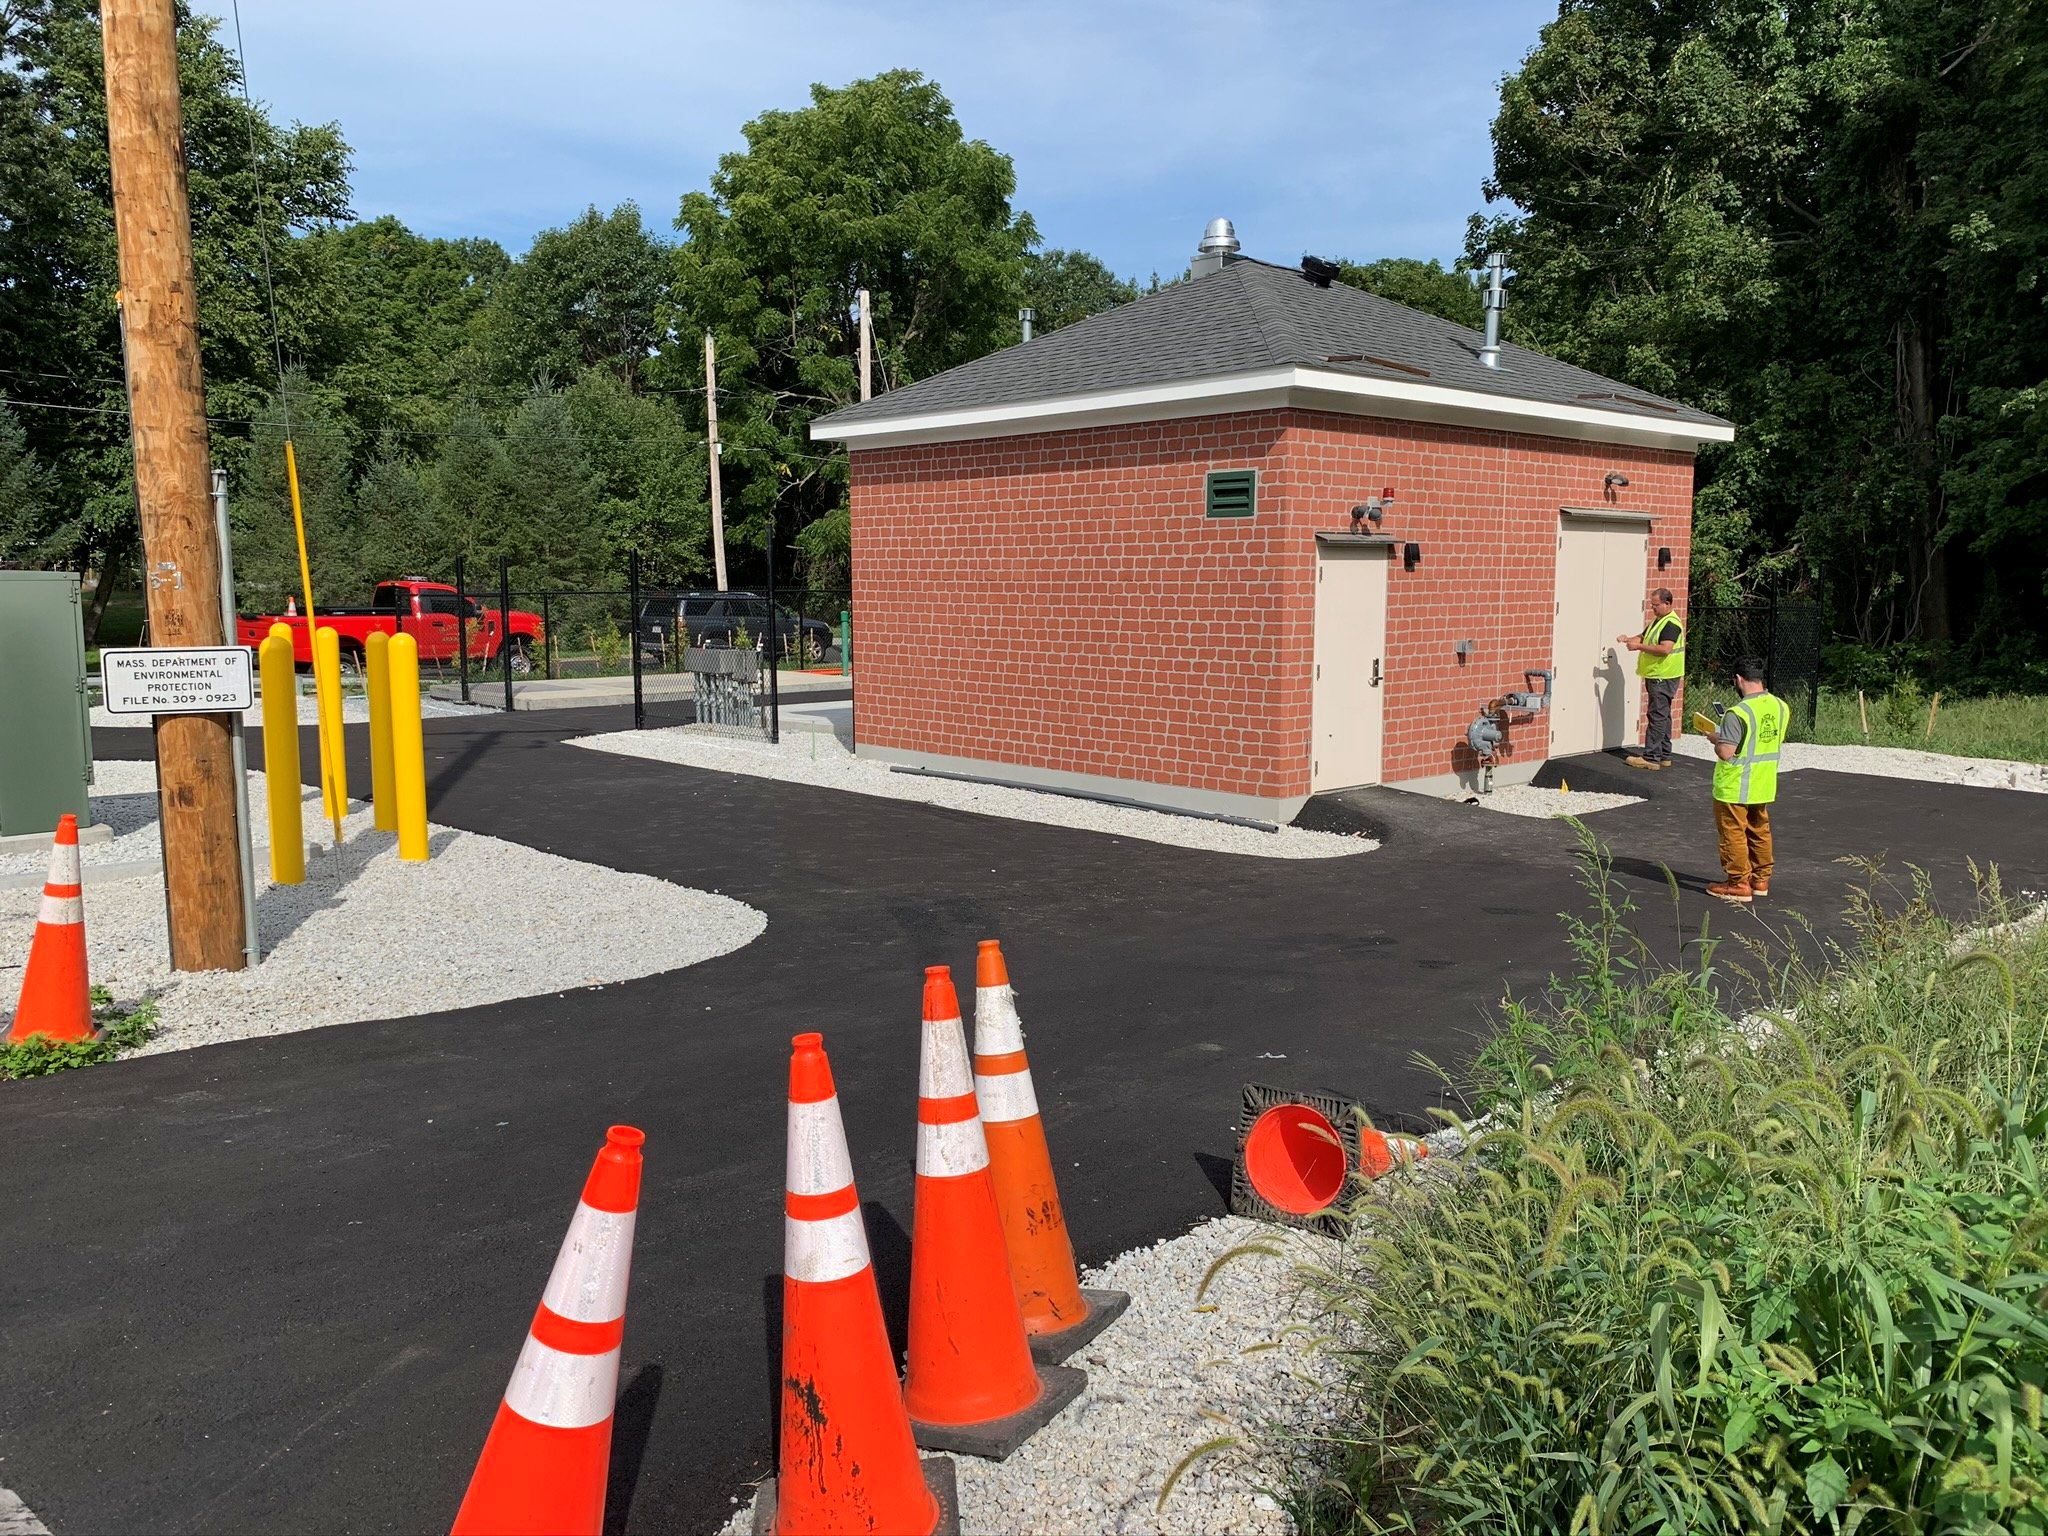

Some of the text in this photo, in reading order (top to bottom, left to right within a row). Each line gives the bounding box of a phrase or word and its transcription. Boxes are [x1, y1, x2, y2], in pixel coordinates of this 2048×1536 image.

[117, 657, 237, 668] MASS. DEPARTMENT OF
[133, 670, 223, 680] ENVIRONMENTAL
[147, 682, 212, 692] PROTECTION
[123, 696, 149, 705] FILE
[152, 696, 170, 704] No.
